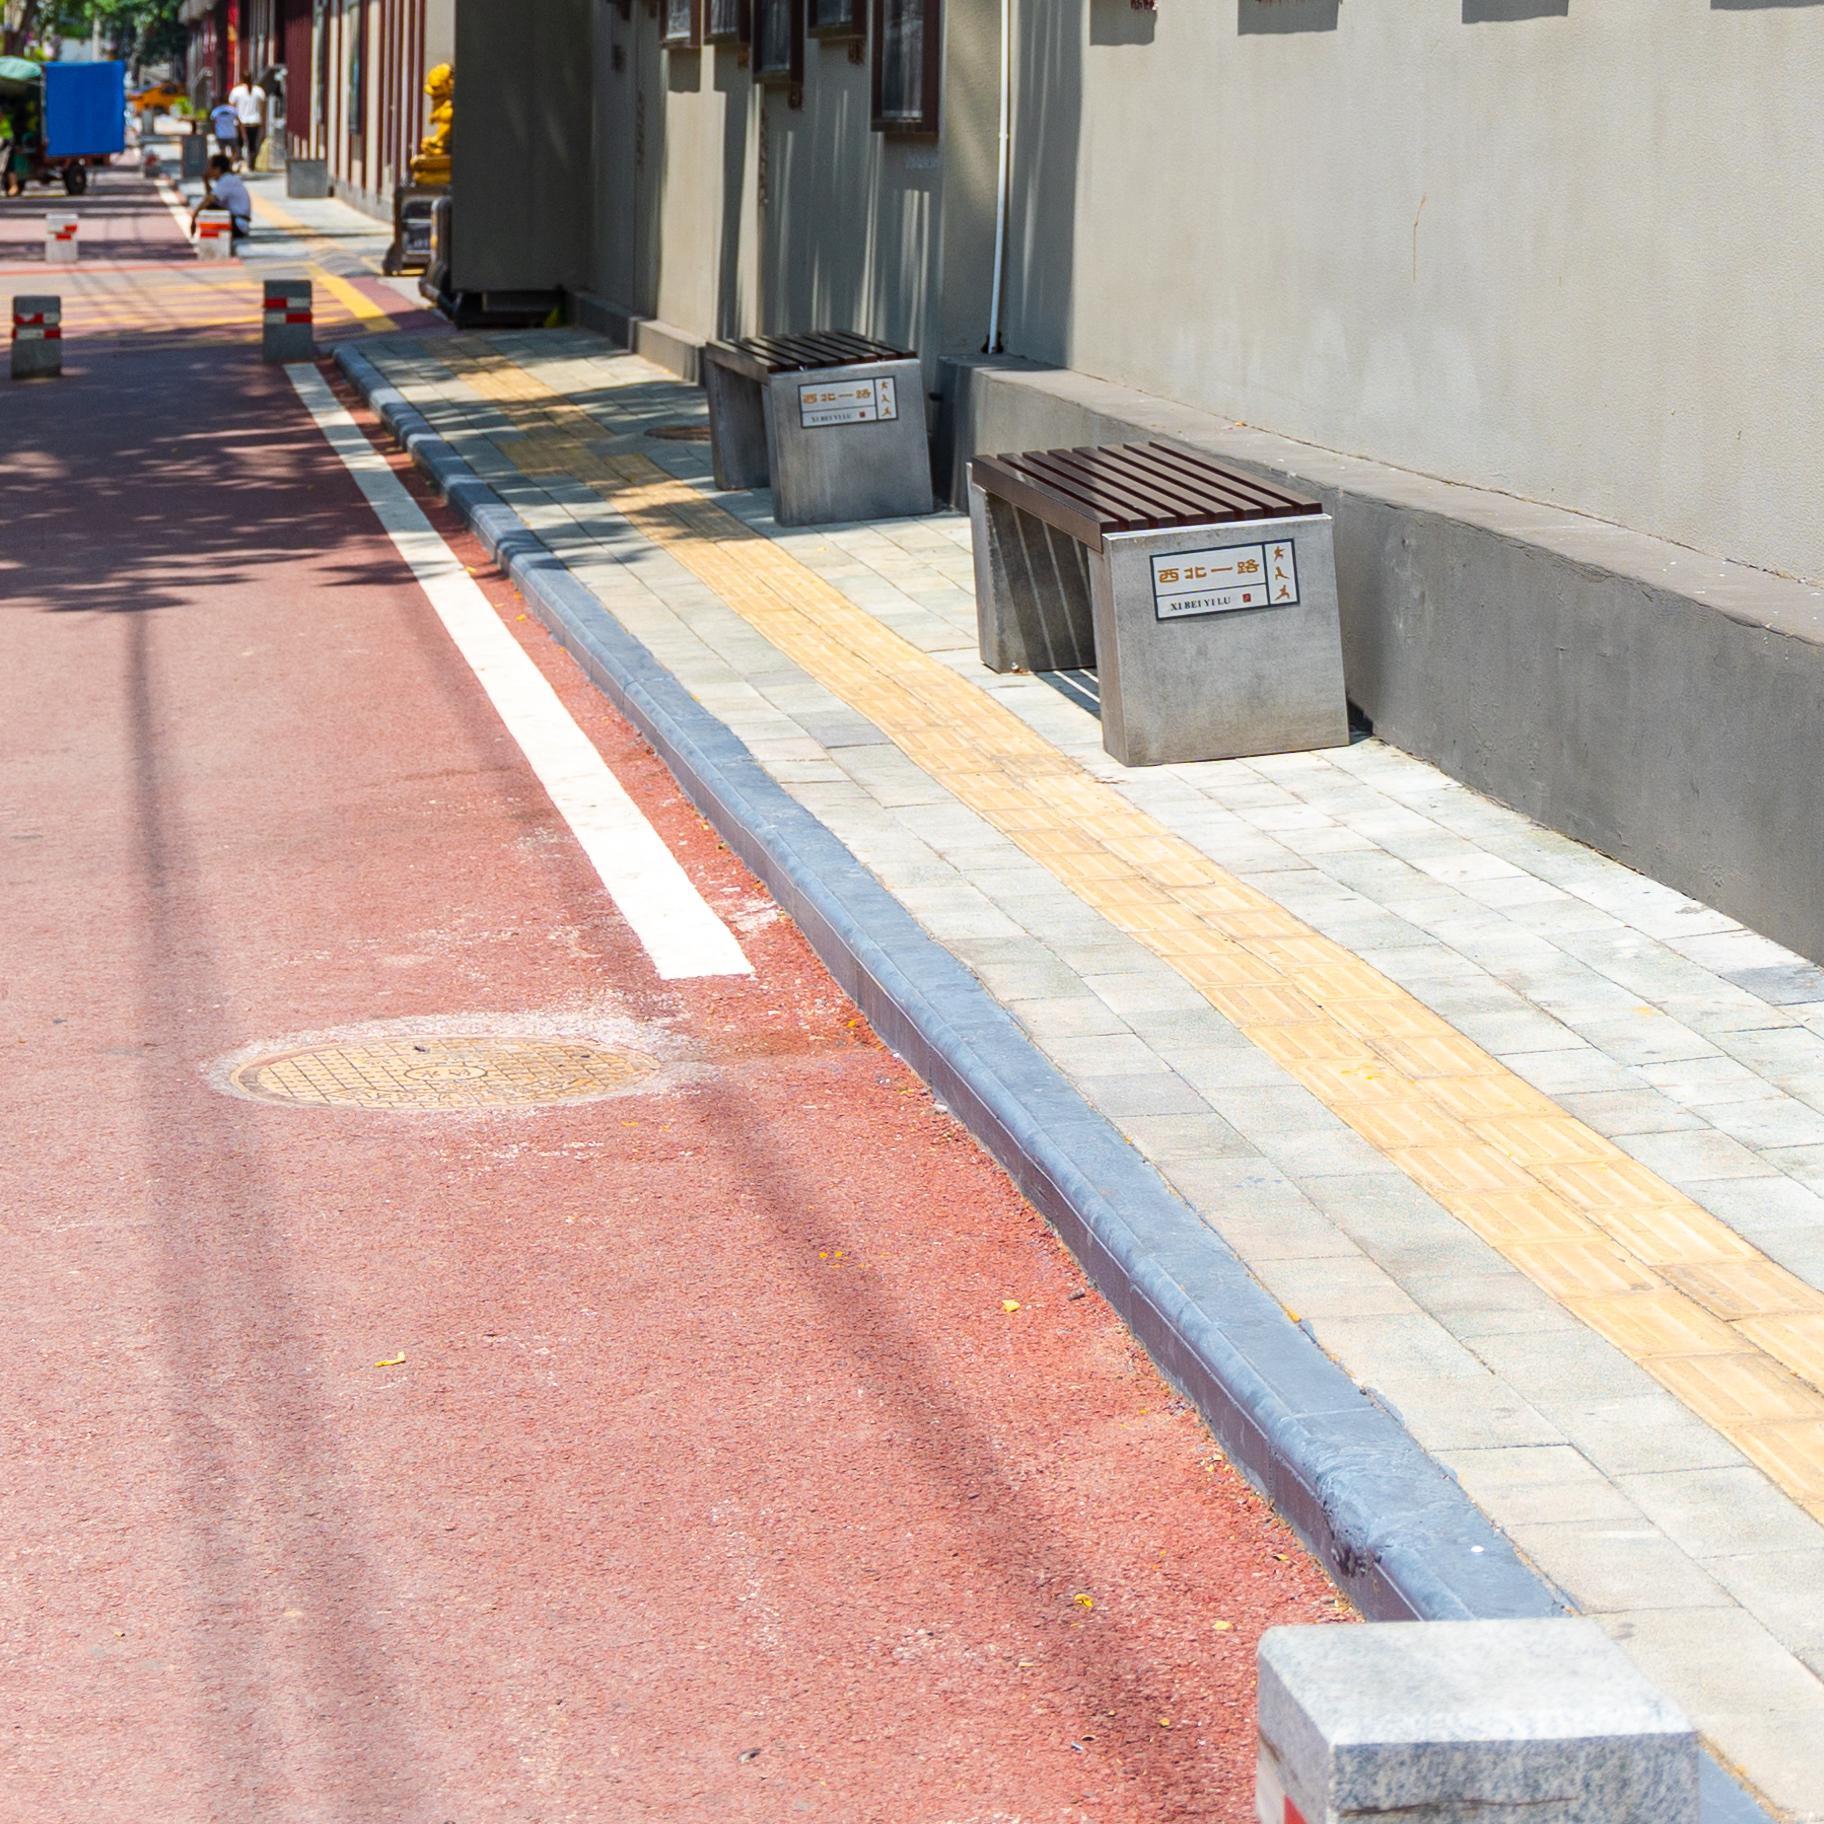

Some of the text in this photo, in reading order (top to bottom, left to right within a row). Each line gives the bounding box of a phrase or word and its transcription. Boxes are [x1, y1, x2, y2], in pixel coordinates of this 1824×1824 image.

[1157, 558, 1261, 584] 西北一路
[1170, 595, 1232, 611] XI BEI YI LU
